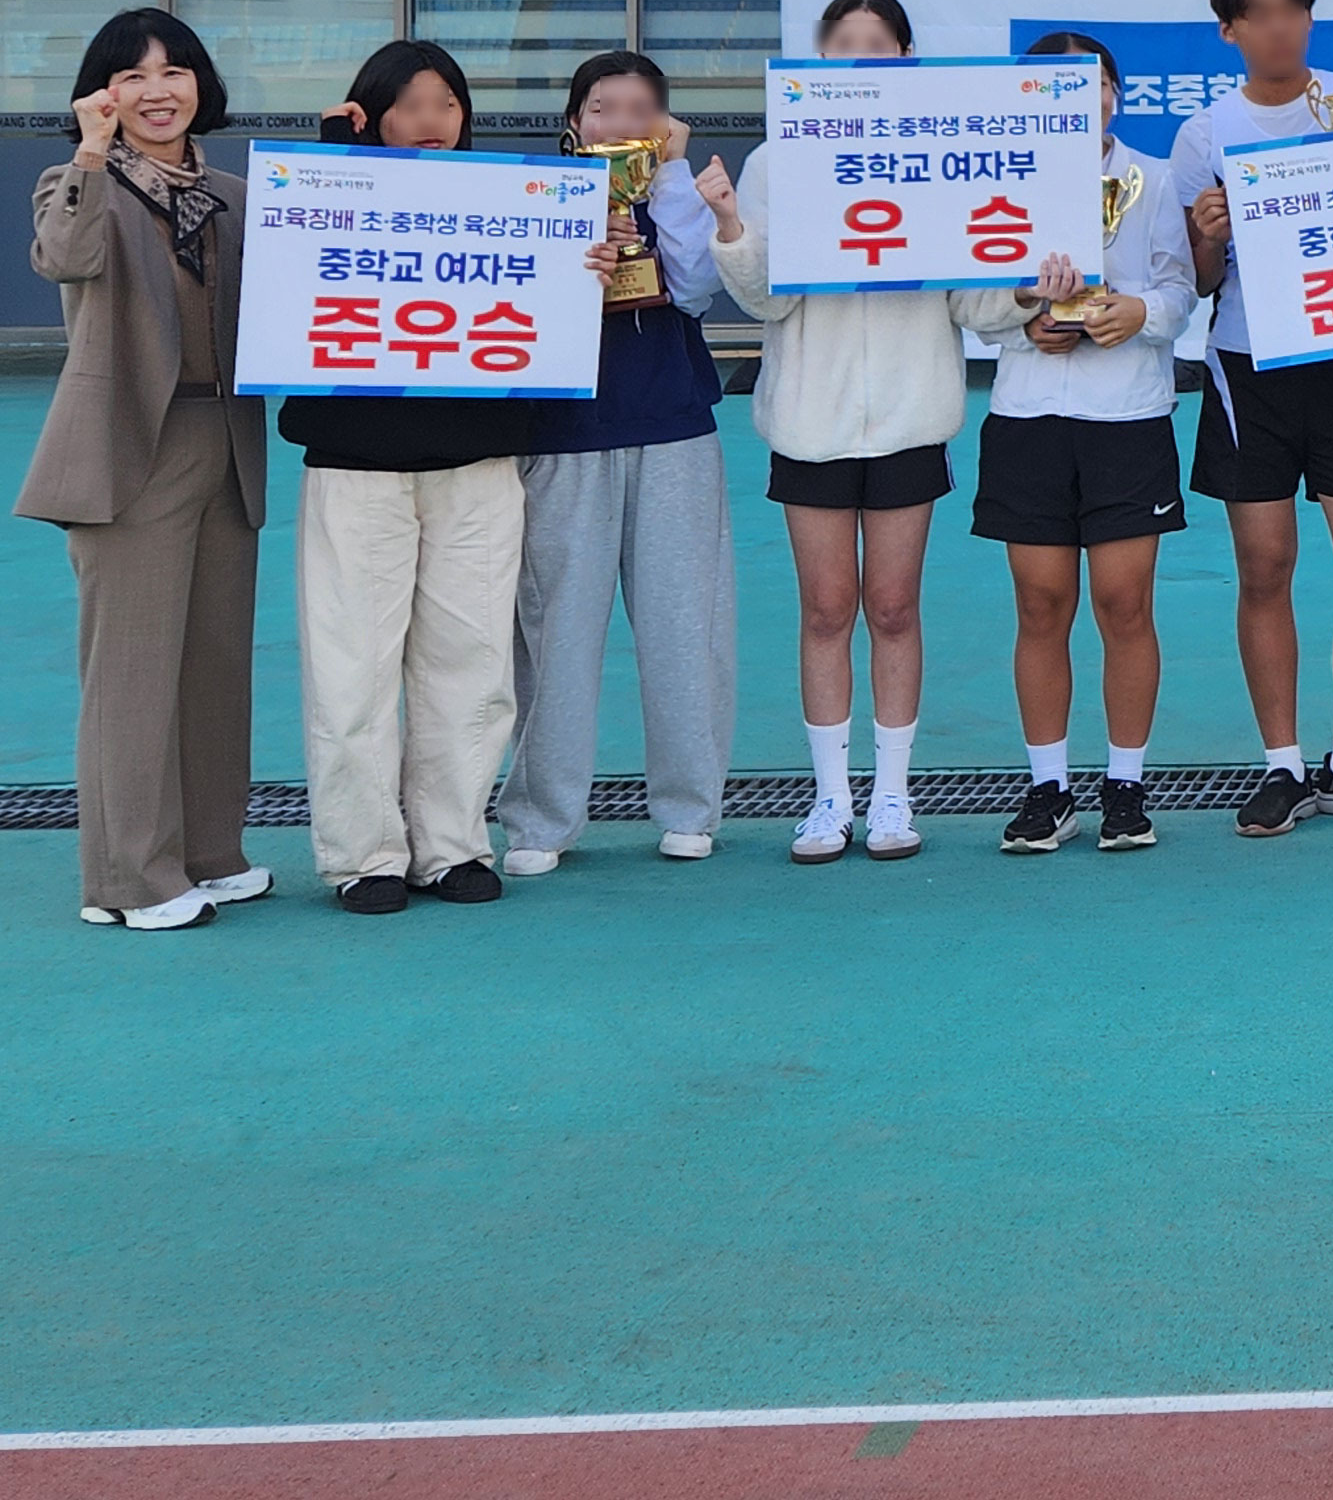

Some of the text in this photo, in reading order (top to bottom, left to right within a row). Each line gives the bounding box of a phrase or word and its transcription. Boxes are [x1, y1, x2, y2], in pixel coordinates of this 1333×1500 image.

[266, 117, 315, 128] COMPLEX
[501, 116, 549, 128] COMPLEX
[781, 119, 863, 139] 교육장배
[966, 114, 1088, 135] 육상경기대회
[835, 151, 1036, 184] 중학교 여자부
[1243, 192, 1321, 221] 교육장배
[261, 208, 354, 231] 교육장배
[464, 215, 593, 240] 육상경기대회
[840, 196, 1032, 265] 우 승
[318, 248, 535, 285] 중학교 여자부
[308, 297, 537, 372] 준우승
